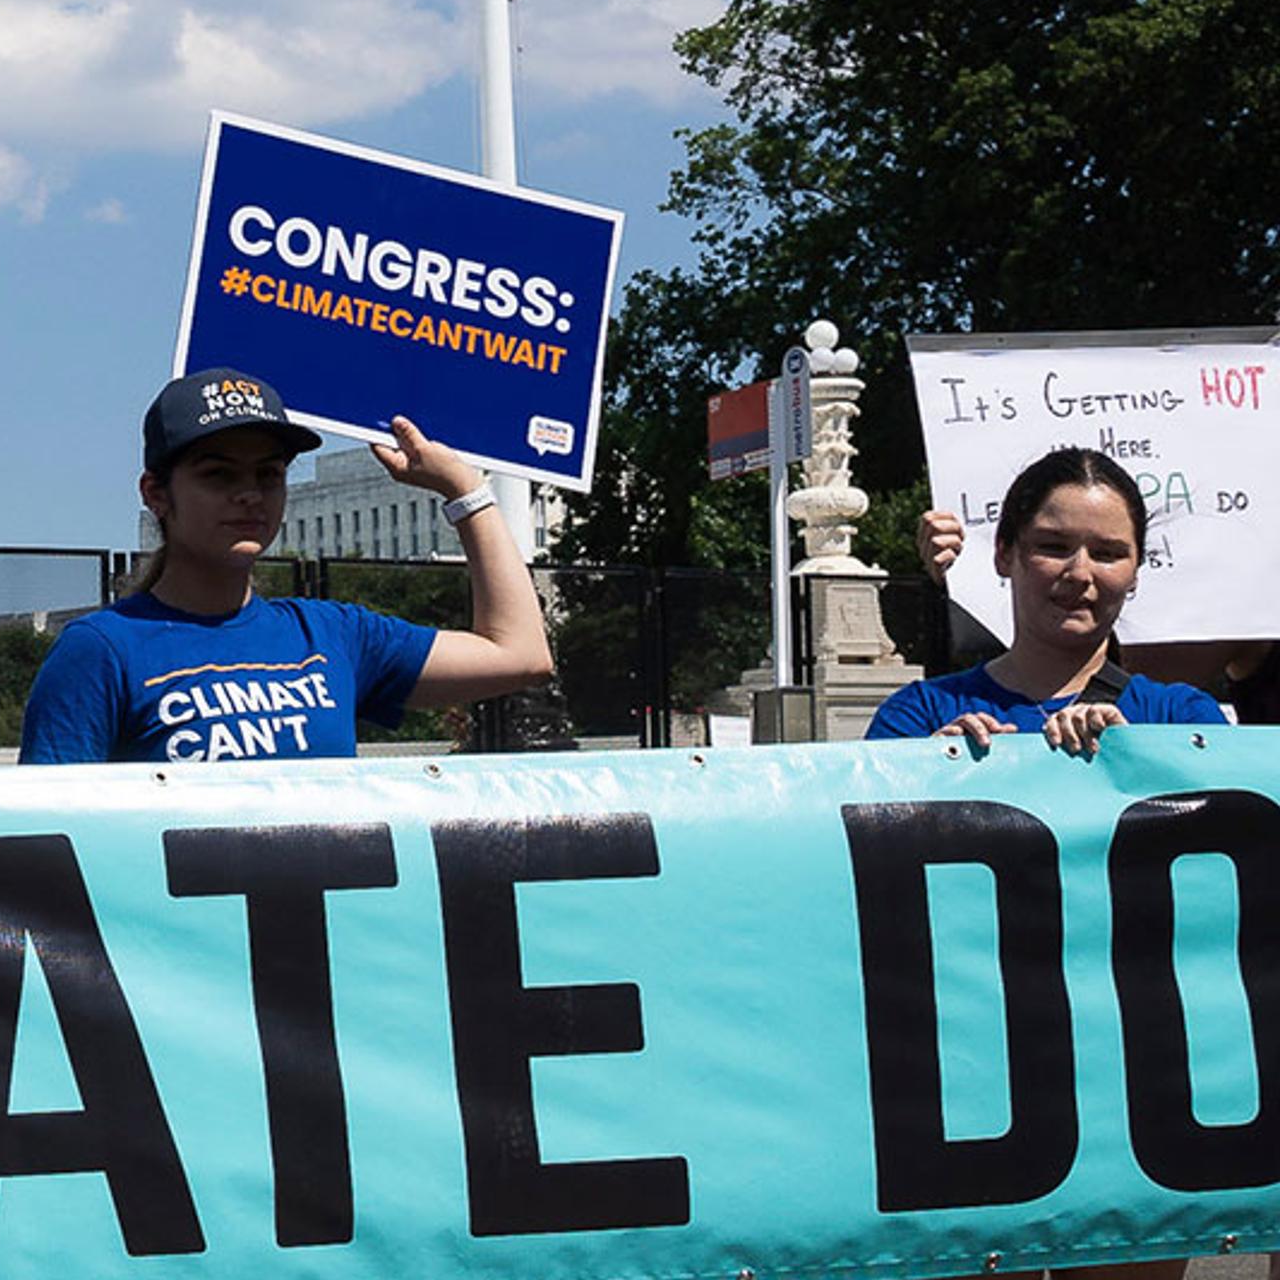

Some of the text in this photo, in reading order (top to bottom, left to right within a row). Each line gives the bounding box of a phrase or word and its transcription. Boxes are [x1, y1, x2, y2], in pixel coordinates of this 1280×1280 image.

[227, 204, 576, 334] CONGRESS:
[219, 265, 567, 375] #CLIMATECANTWAIT
[201, 379, 262, 398] #ACT
[206, 392, 264, 411] NOW
[1200, 366, 1266, 410] HOT
[198, 411, 221, 425] ON
[960, 472, 1250, 526] LE PA DO
[158, 672, 337, 726] CLIMATE
[166, 714, 309, 763] CAN'T
[841, 788, 1280, 1214] DO
